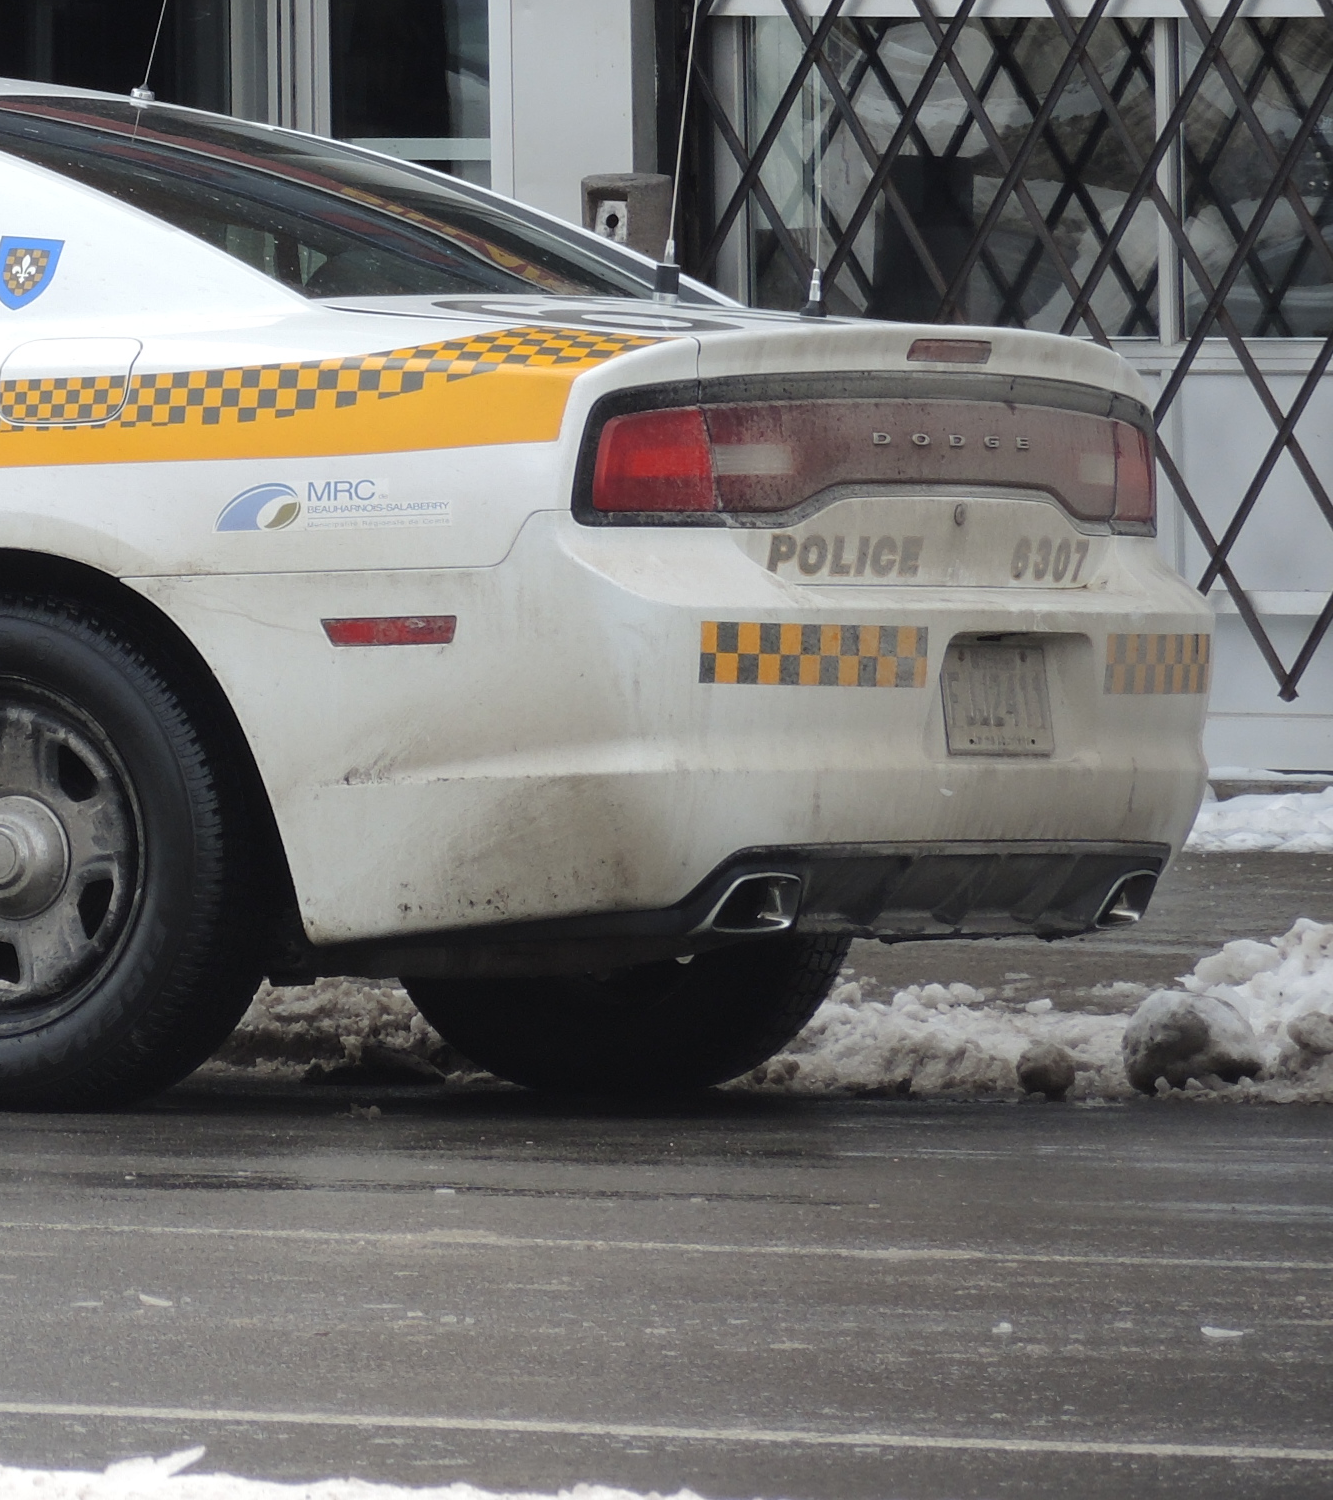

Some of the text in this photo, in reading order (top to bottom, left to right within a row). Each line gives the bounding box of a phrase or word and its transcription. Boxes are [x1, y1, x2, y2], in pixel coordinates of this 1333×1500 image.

[872, 431, 1032, 450] DODGE
[307, 479, 376, 502] MRC
[307, 501, 450, 514] BEAUHARNOIS-SALABERRY
[766, 533, 1090, 584] POLICE 6307
